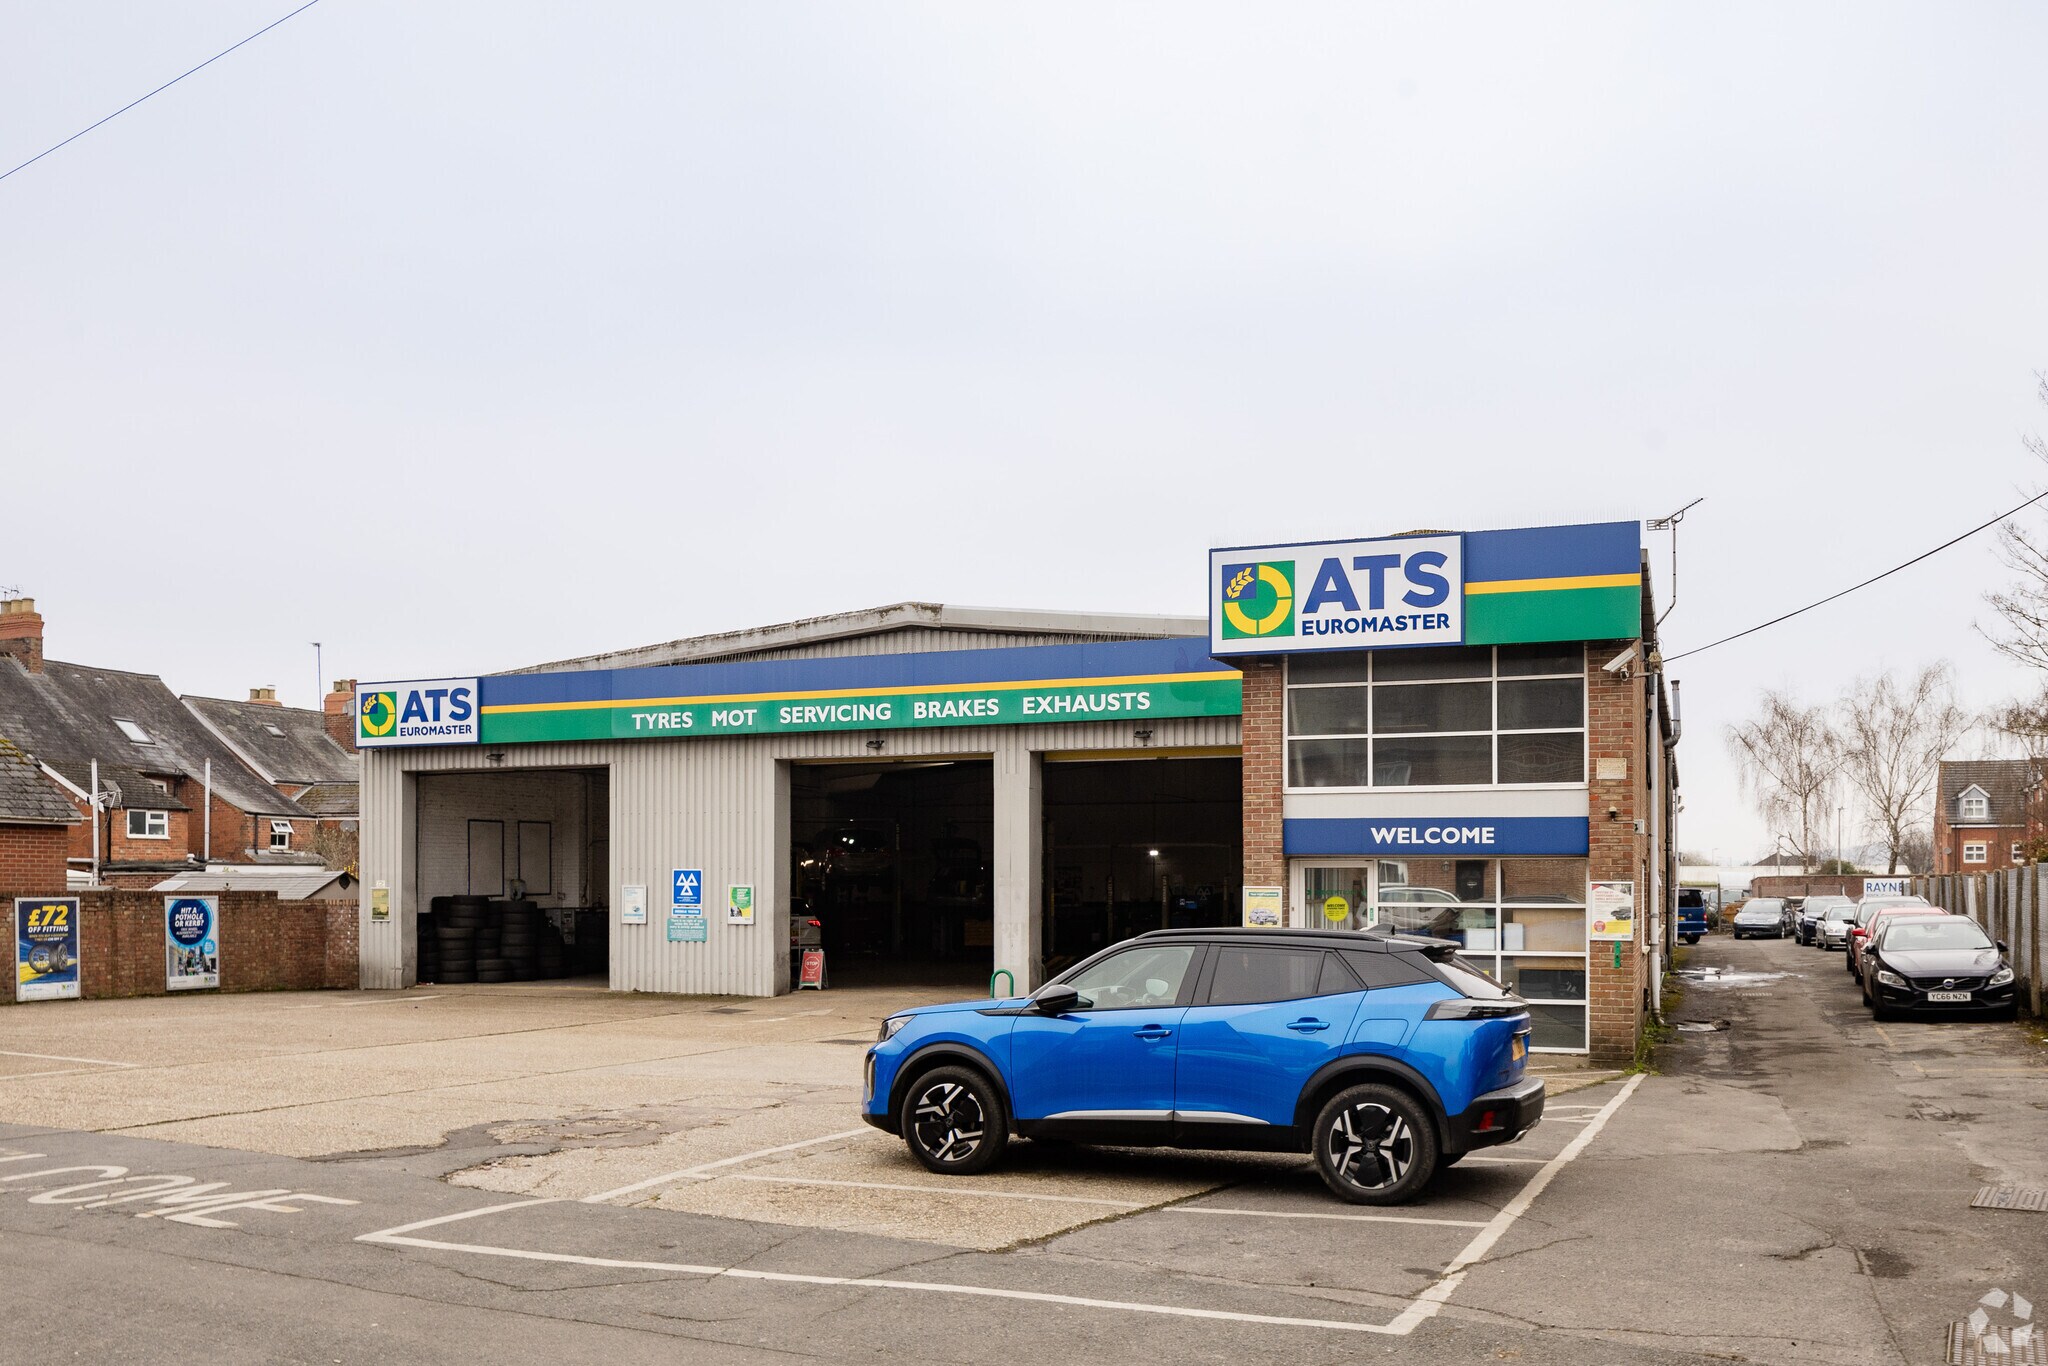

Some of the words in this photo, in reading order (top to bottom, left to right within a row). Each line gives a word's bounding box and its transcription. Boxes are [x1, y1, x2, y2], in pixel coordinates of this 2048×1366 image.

[1302, 551, 1450, 614] ATS
[1302, 613, 1450, 636] EUROMASTER
[400, 688, 472, 723] ATS
[632, 712, 693, 729] TYRES
[712, 709, 757, 727] MOT
[780, 703, 891, 724] SERVICING
[914, 698, 999, 719] BRAKES
[1022, 692, 1150, 715] EXHAUSTS
[400, 725, 472, 736] EUROMASTER
[1370, 827, 1495, 844] WELCOME
[28, 905, 68, 926] £72
[42, 925, 69, 933] FITTING
